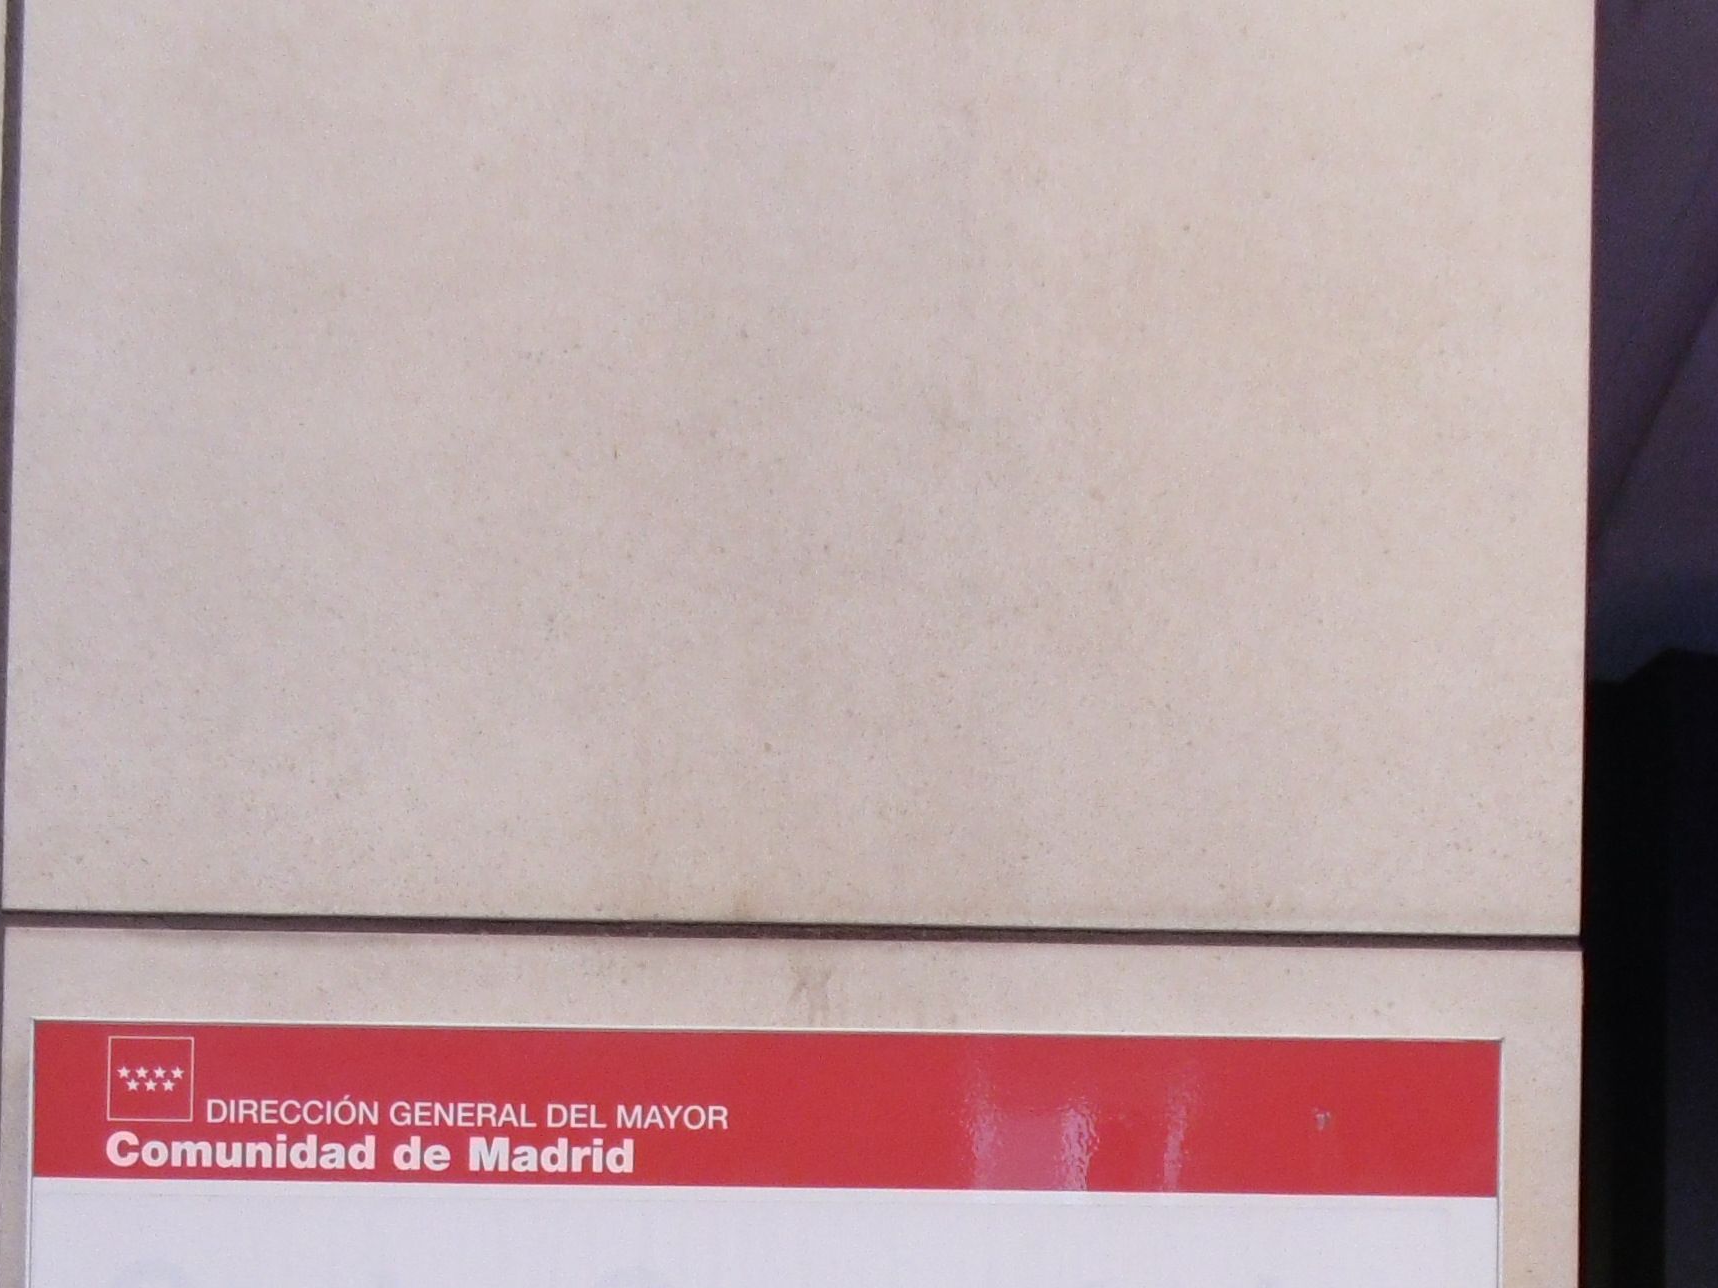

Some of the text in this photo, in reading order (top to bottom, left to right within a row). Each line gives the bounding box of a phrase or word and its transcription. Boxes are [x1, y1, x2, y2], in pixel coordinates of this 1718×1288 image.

[206, 1094, 728, 1130] DIRECCIÓN GENERAL DEL MAYOR
[105, 1130, 634, 1174] Comunidad de Madrid
